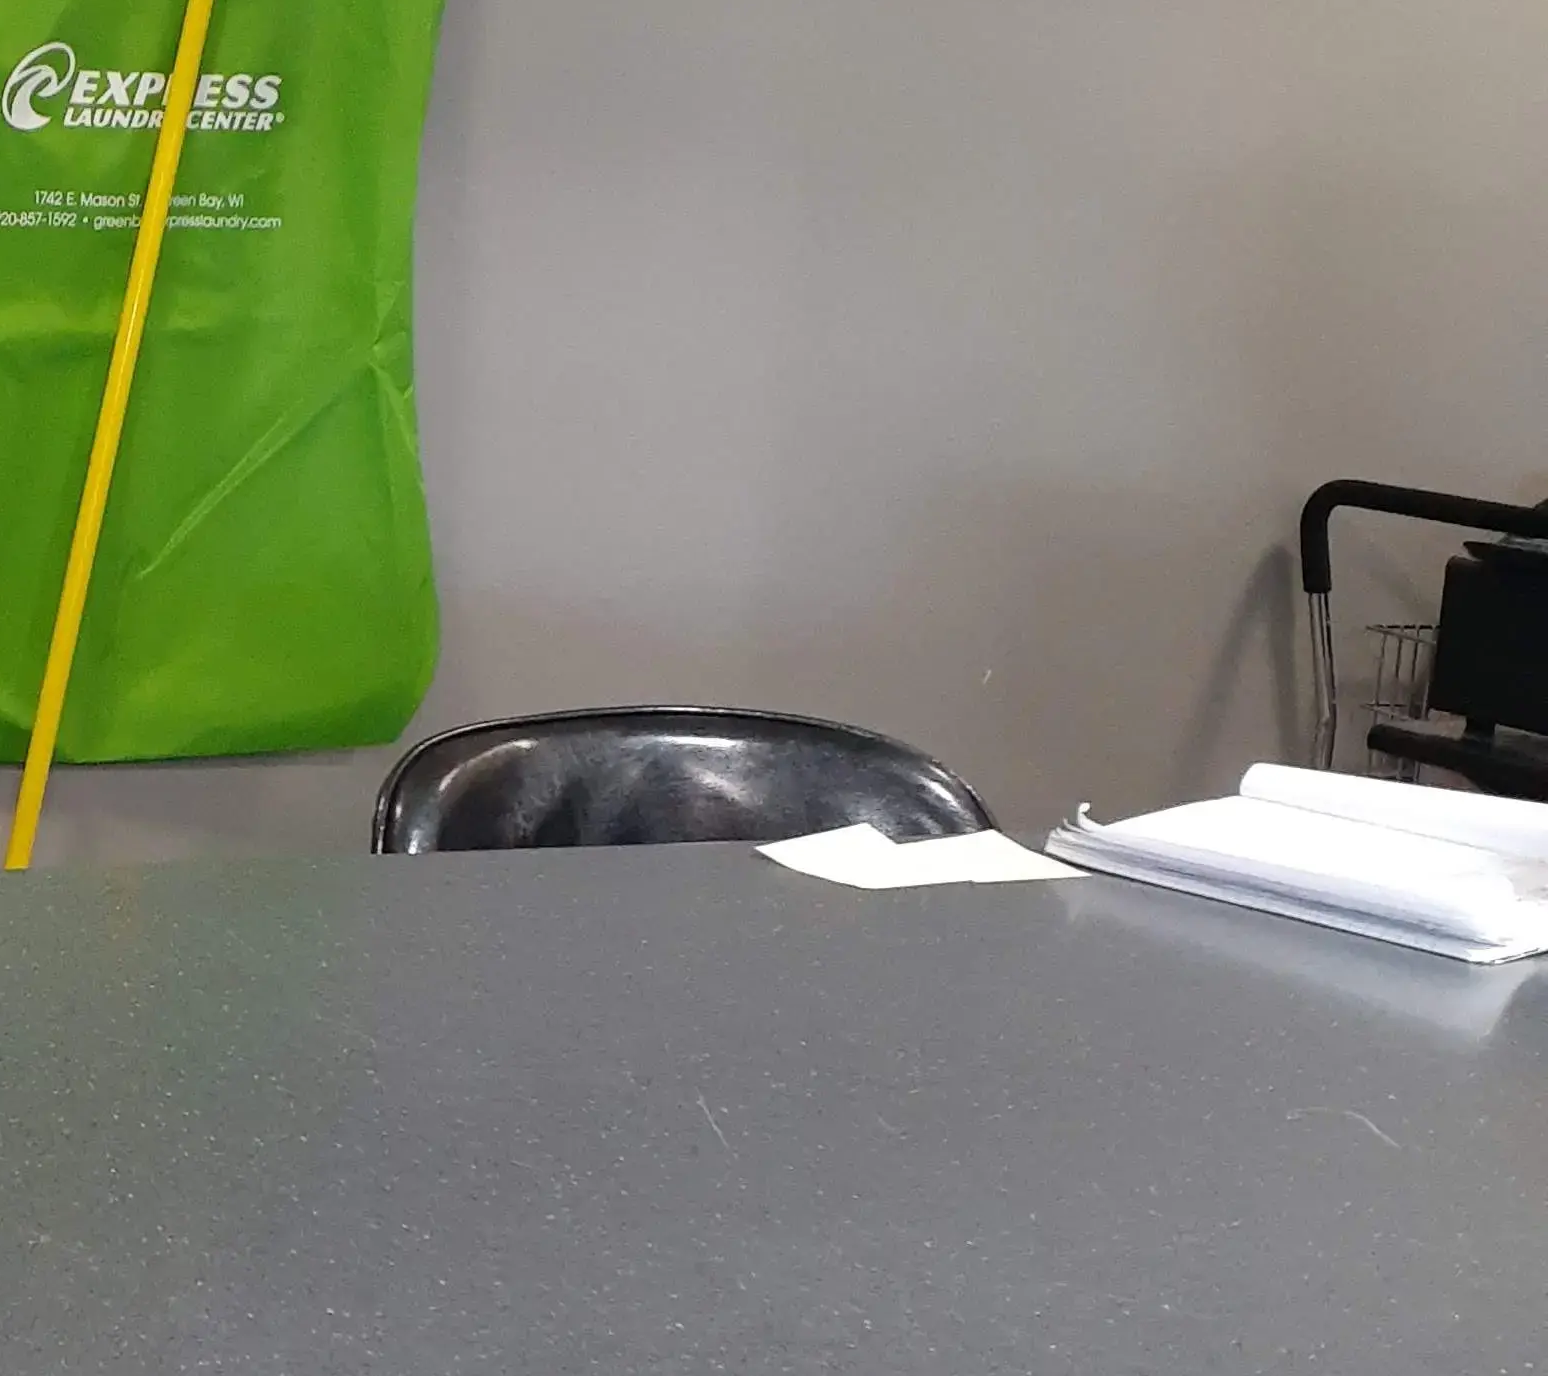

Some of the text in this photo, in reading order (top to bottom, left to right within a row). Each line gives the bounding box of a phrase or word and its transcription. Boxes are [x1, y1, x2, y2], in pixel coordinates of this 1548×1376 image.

[68, 69, 283, 111] EXPESS
[63, 106, 166, 130] LAUNDR
[35, 189, 64, 207] 1742
[80, 191, 126, 209] Mason
[167, 193, 197, 209] reen
[227, 192, 245, 209] WI
